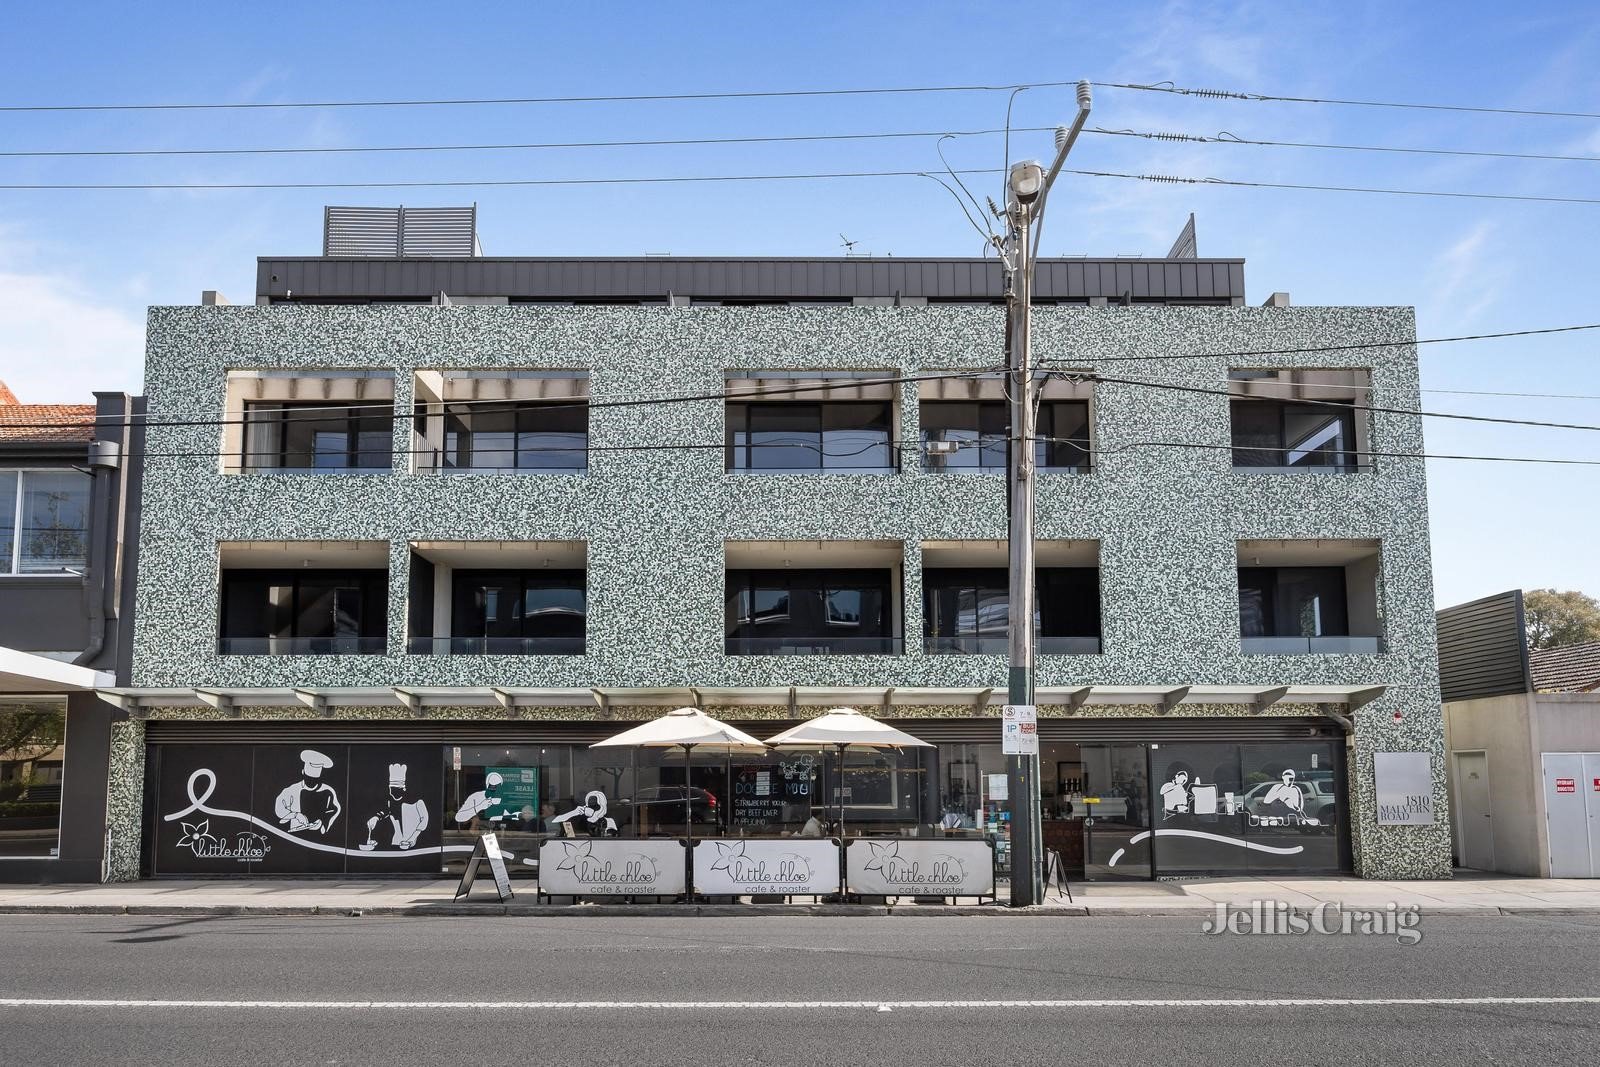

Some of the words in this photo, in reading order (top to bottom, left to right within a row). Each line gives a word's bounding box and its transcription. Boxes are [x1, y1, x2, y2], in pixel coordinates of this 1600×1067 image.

[1006, 724, 1016, 732] 1P
[736, 782, 778, 794] DOGE
[1406, 795, 1430, 806] 1810
[1381, 805, 1430, 813] MALVERN
[1380, 812, 1410, 820] ROAD
[198, 838, 231, 856] little
[232, 838, 263, 856] chloe
[580, 860, 617, 882] little
[620, 860, 652, 882] chloe
[735, 860, 771, 882] little
[774, 860, 806, 882] chloe
[888, 862, 925, 883] little
[928, 862, 960, 883] chloe
[590, 885, 612, 894] cafe
[616, 885, 622, 894] &
[624, 885, 656, 894] roaster
[745, 884, 766, 893] cafe
[770, 884, 776, 893] &
[778, 884, 811, 893] roaster
[898, 886, 920, 894] cafe
[924, 886, 930, 894] &
[932, 886, 964, 894] roaster
